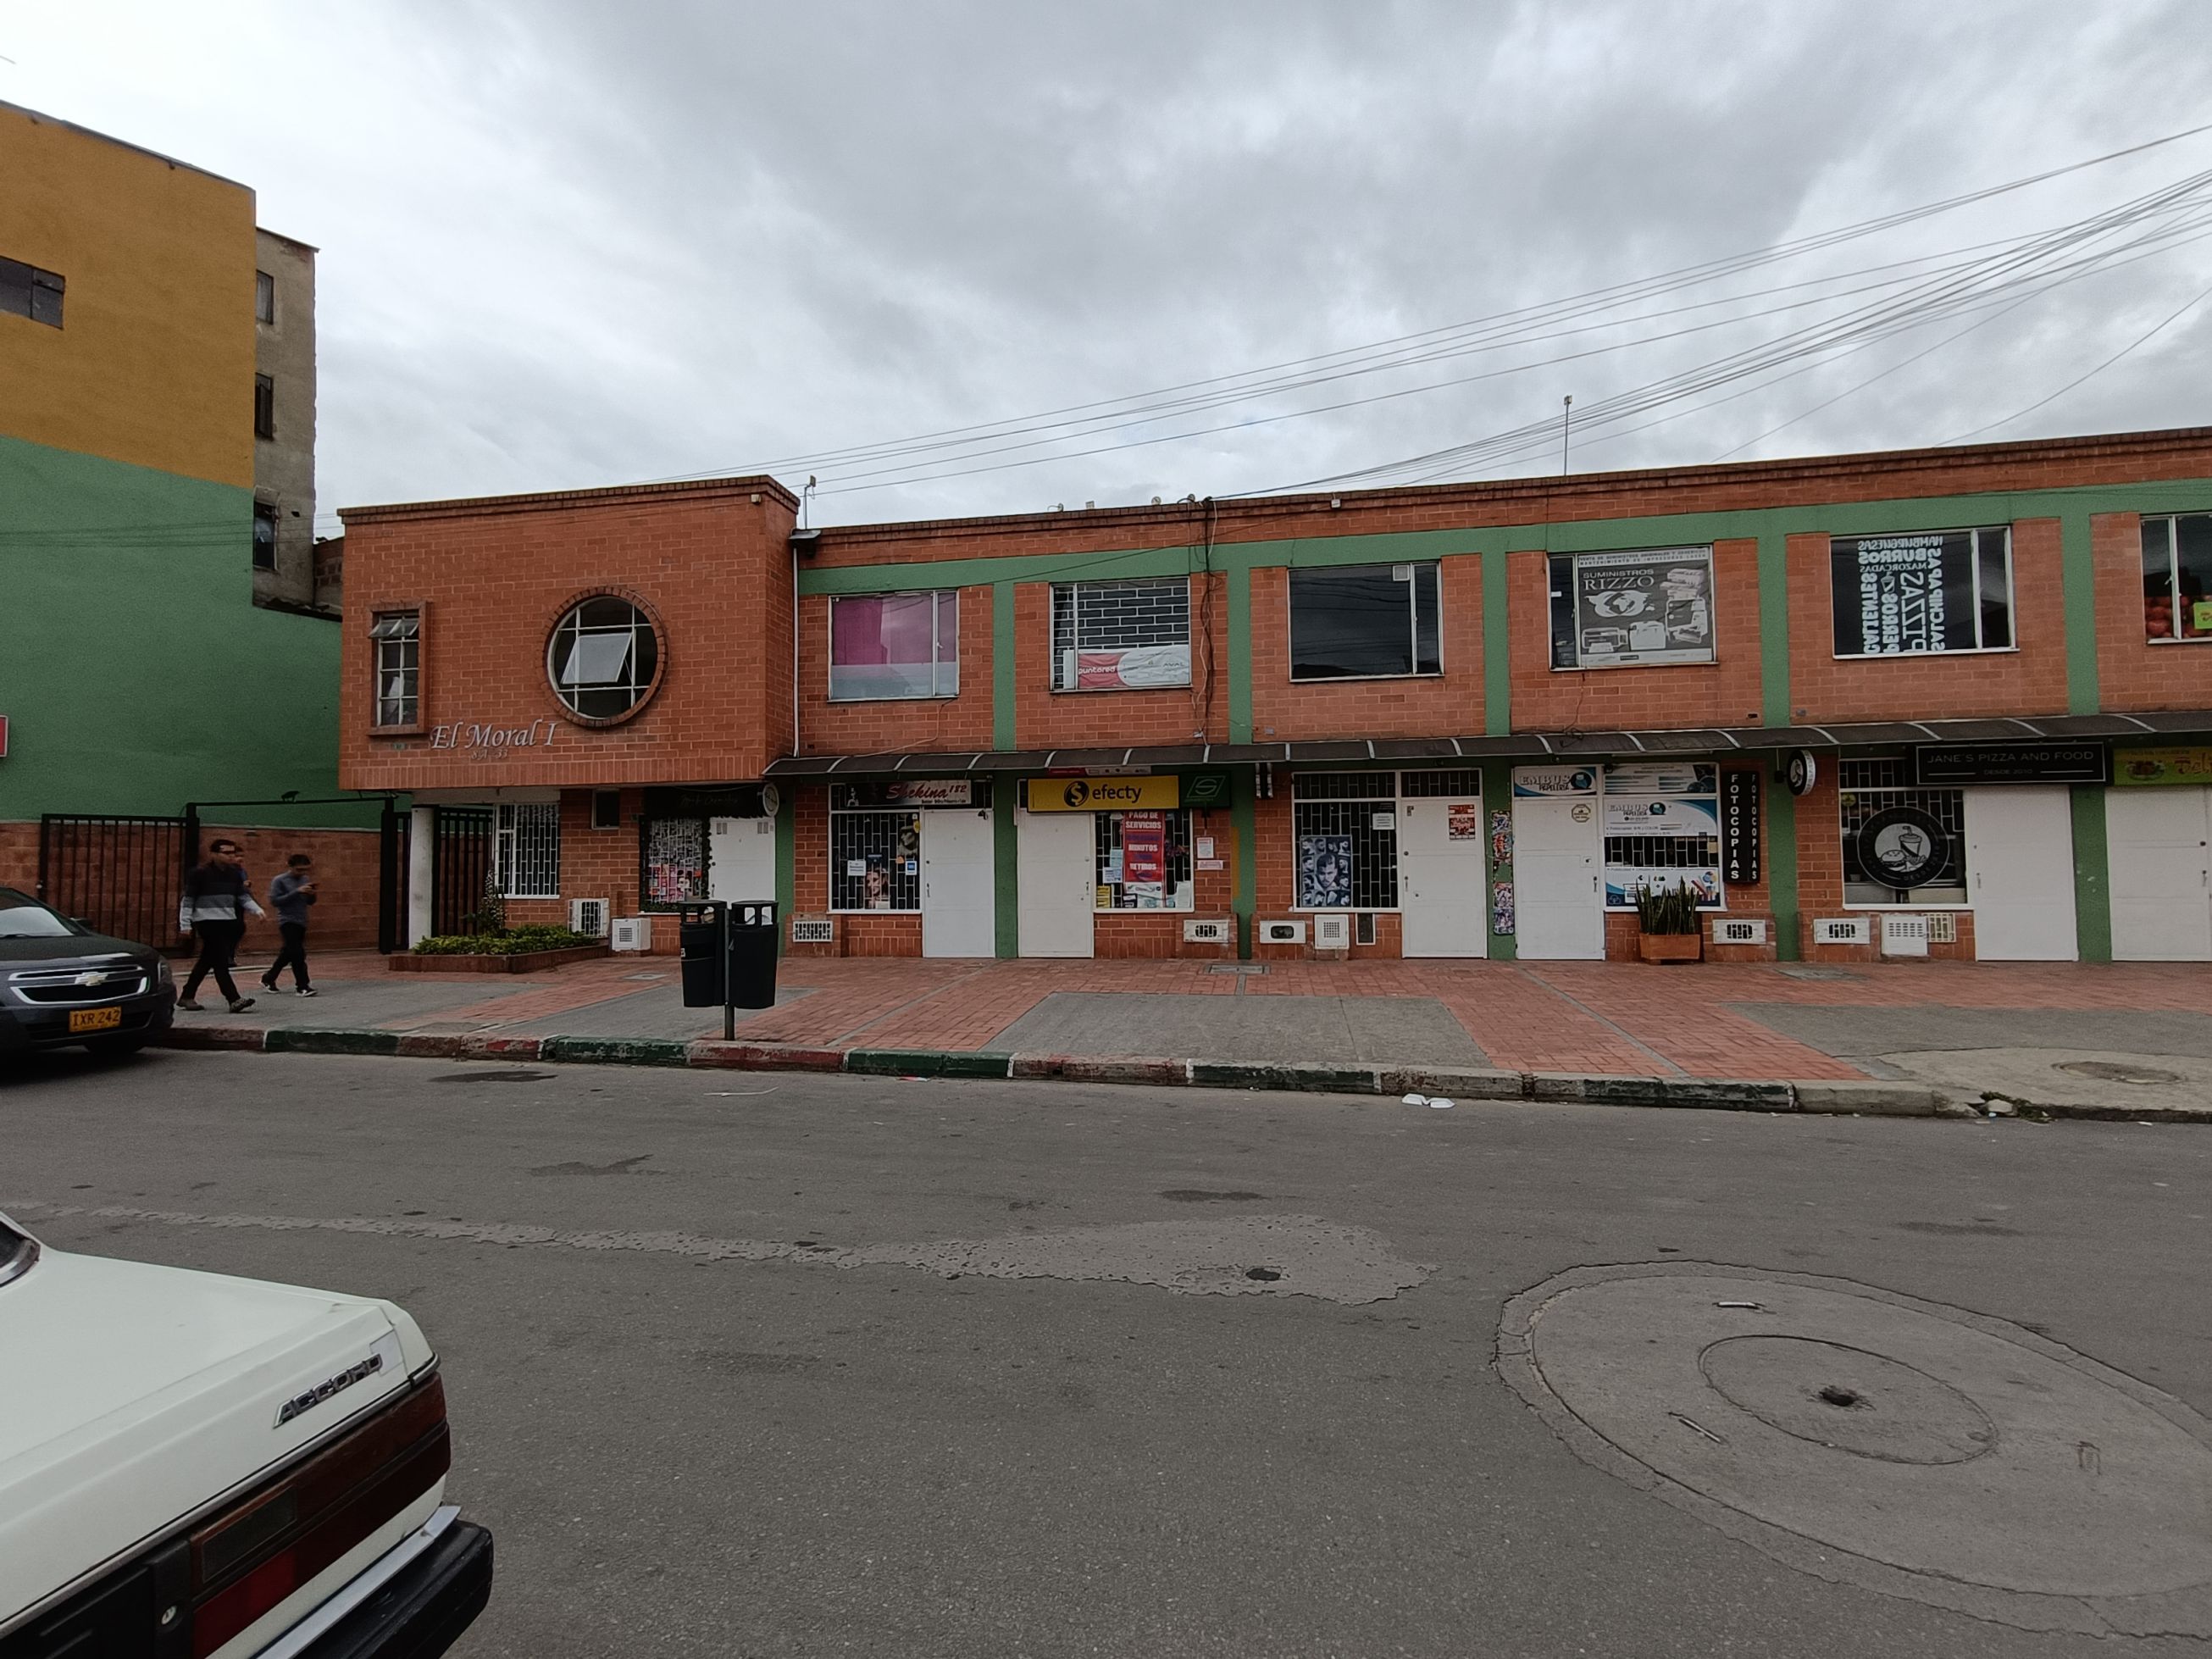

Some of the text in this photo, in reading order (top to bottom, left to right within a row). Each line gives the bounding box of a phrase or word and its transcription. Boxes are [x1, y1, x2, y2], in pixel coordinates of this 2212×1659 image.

[1583, 569, 1655, 580] SUMINISTROS
[1583, 575, 1655, 591] RIZZO
[430, 721, 463, 748] El
[464, 719, 543, 749] Moral
[1978, 752, 2017, 763] PIZZA
[2020, 752, 2050, 762] AND
[2054, 750, 2095, 761] FOOD
[1092, 784, 1142, 803] efecty
[1128, 811, 1158, 819] PAGO DE
[1125, 821, 1161, 830] SERVICIOS
[1729, 774, 1740, 879] FOTOCOPIAS
[73, 1009, 120, 1027] IXR 242
[273, 1353, 384, 1429] ACCORD
